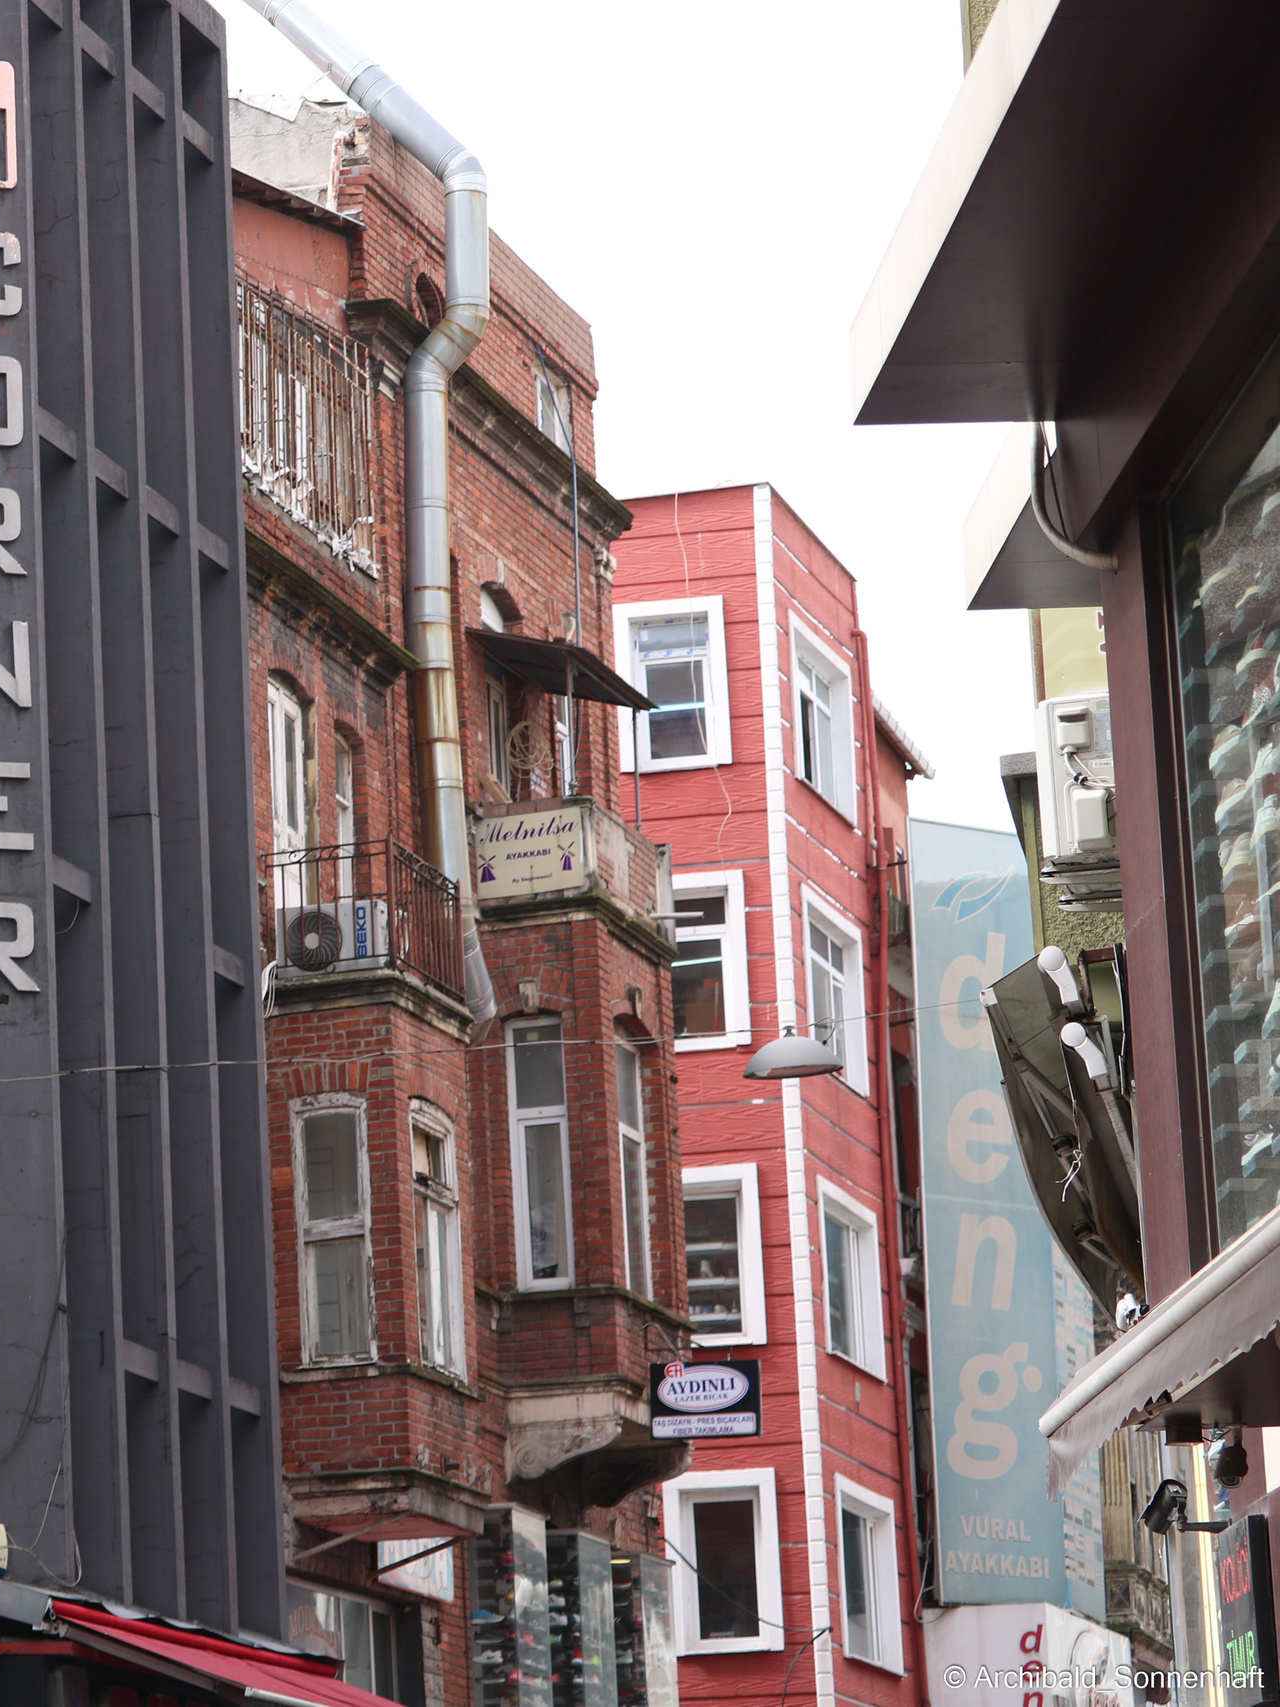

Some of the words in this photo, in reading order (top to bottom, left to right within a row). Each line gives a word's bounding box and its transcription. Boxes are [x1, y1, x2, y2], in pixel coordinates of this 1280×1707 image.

[506, 848, 552, 860] AYAKKABI
[356, 906, 368, 958] BEKO
[667, 1377, 736, 1397] AYDINLI
[960, 1514, 1031, 1542] VURAL
[943, 1549, 1050, 1580] AYAKKABI
